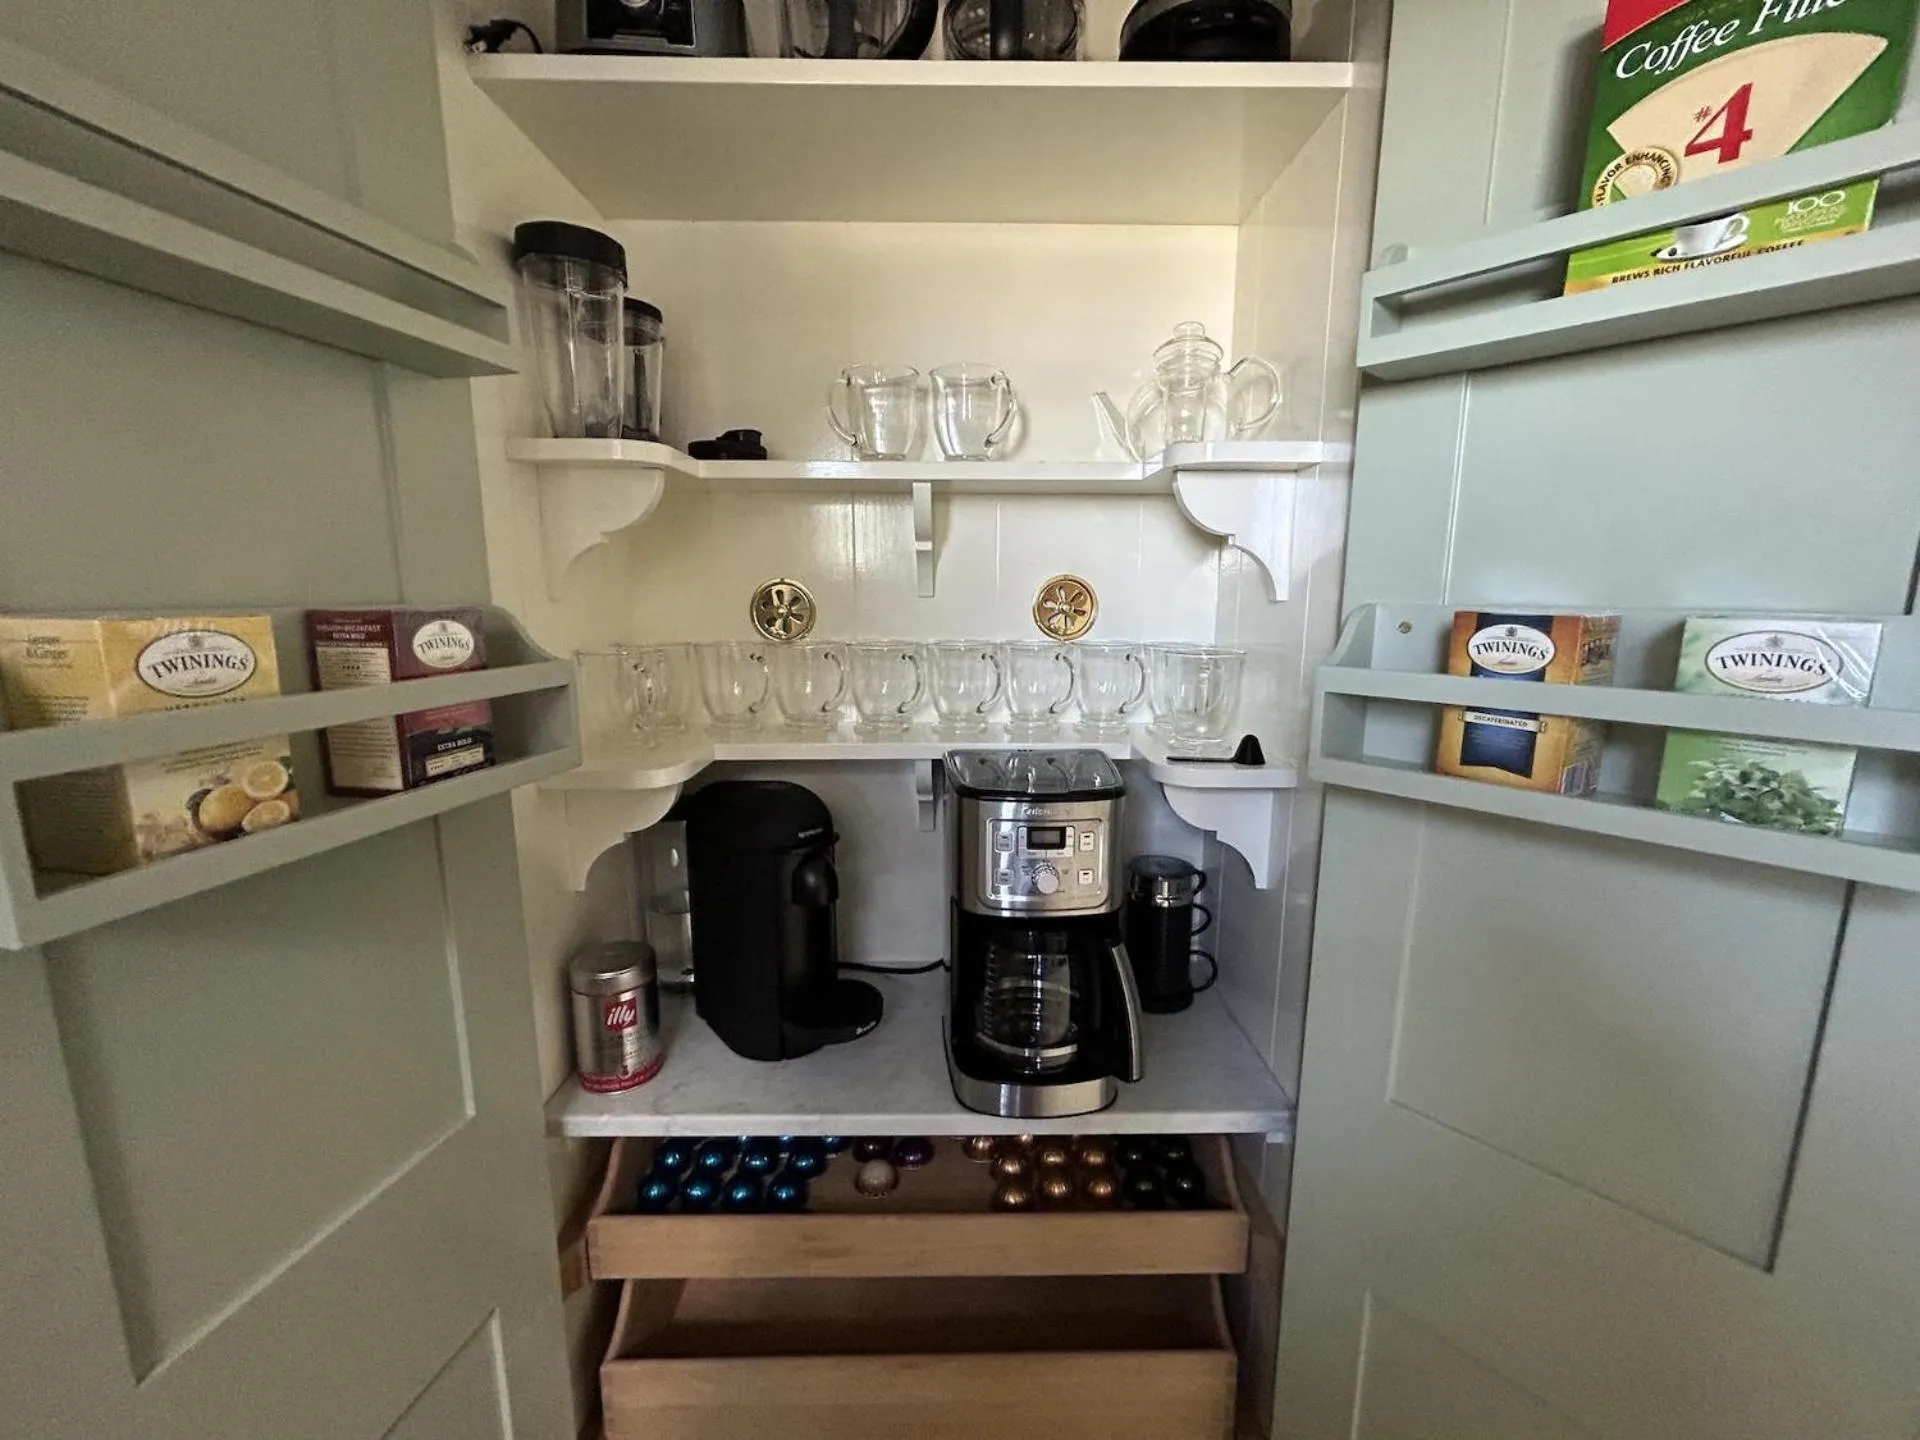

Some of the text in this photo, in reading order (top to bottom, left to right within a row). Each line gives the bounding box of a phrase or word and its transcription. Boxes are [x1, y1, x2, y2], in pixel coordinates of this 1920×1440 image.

[1616, 19, 1740, 79] Coffee
[1787, 190, 1846, 214] 100
[1612, 270, 1650, 284] BREWS
[1653, 264, 1681, 278] RICH
[416, 636, 470, 654] TWININGS
[1473, 640, 1548, 660] TWININGS
[148, 653, 248, 679] TWININGS
[1716, 653, 1830, 676] TWININGS
[607, 1005, 635, 1028] illy
